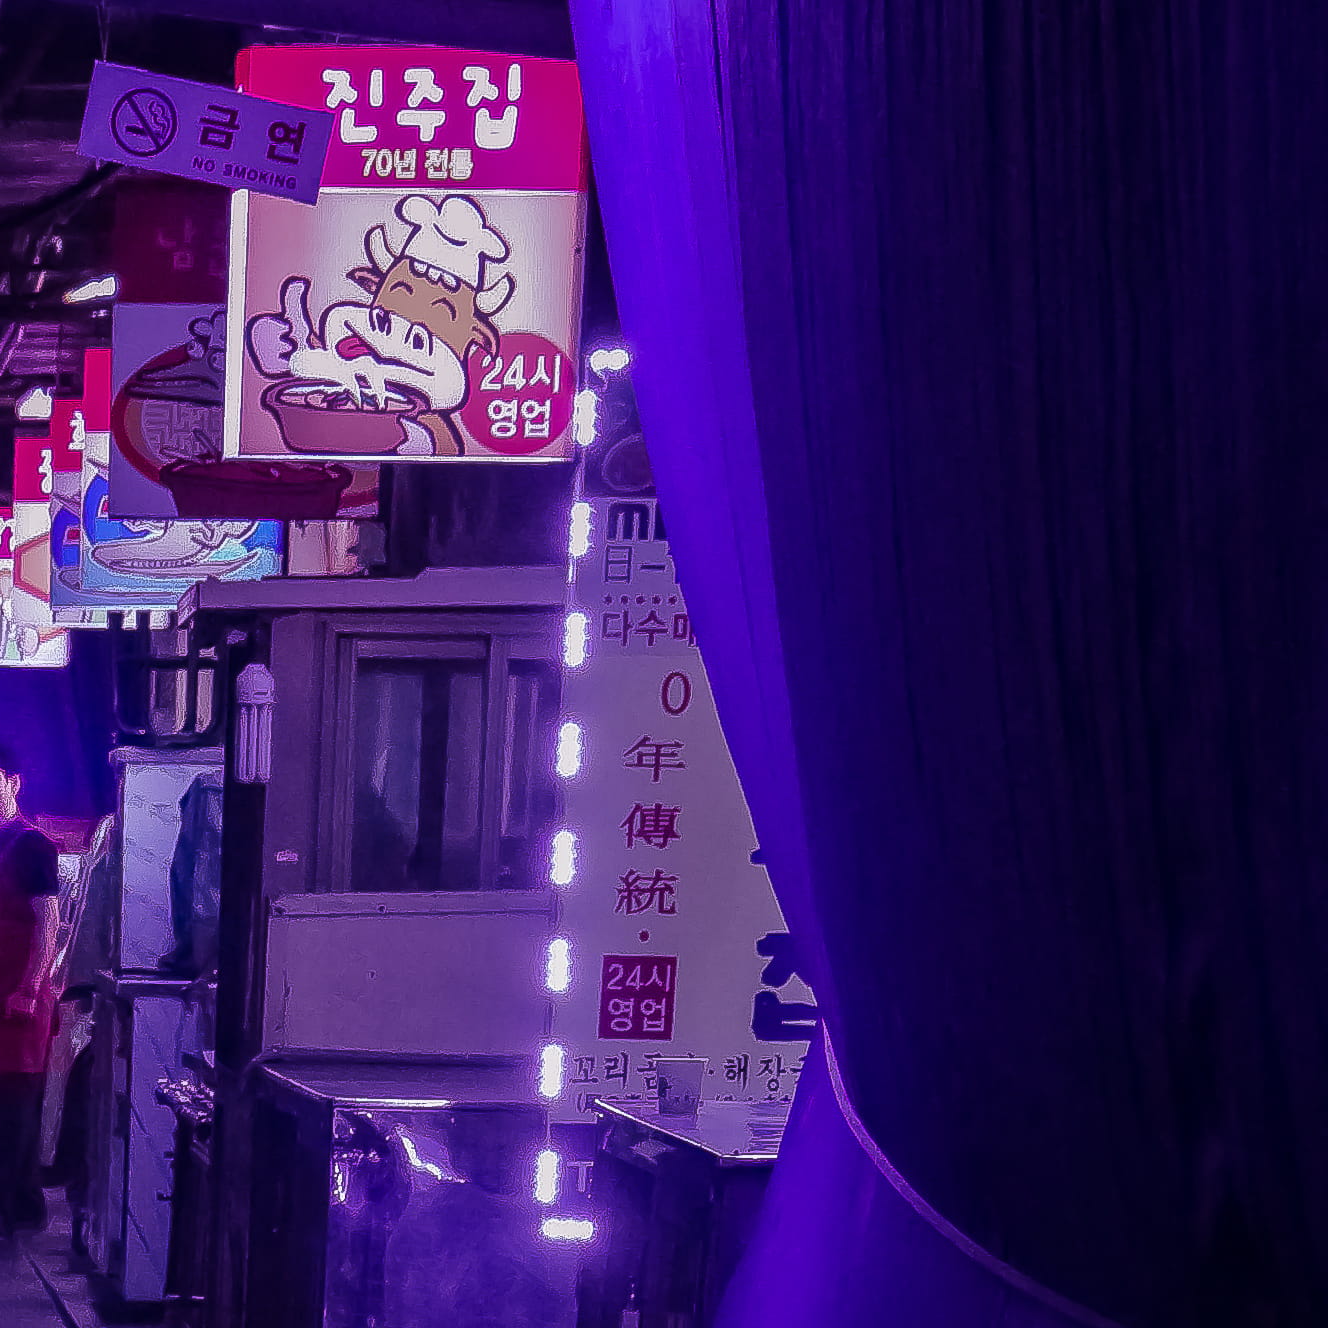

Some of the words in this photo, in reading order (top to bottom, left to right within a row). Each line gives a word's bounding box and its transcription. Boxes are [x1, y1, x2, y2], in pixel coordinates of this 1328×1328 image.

[322, 63, 522, 149] 진주집
[199, 103, 306, 164] 금연
[192, 155, 215, 172] NO
[223, 163, 297, 190] SMOKING
[361, 149, 417, 179] 70년
[425, 148, 474, 180] 전통
[480, 353, 560, 394] 24시
[487, 398, 551, 438] 영업
[607, 964, 671, 993] 24시
[607, 998, 667, 1033] 영업
